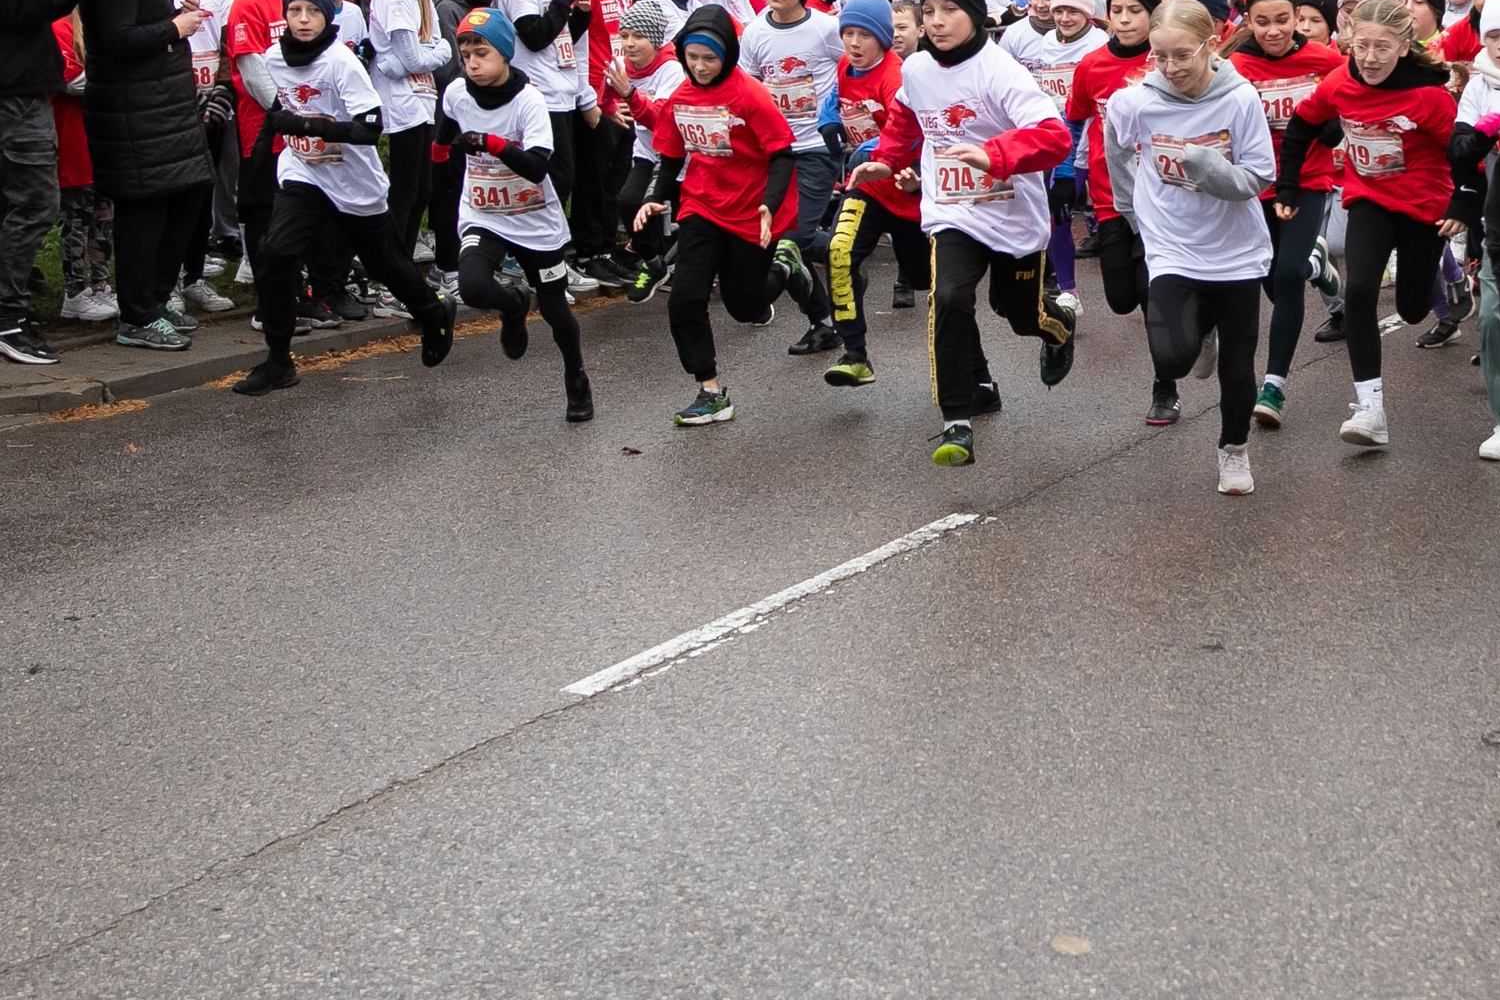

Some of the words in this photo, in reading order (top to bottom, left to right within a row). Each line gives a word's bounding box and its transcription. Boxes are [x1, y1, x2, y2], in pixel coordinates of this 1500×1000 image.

[270, 25, 287, 38] BIE
[1262, 96, 1294, 120] 218
[678, 122, 708, 146] 263
[1346, 140, 1370, 166] 19
[938, 166, 976, 192] 274
[472, 185, 511, 207] 341
[829, 197, 867, 322] LONSDALE
[1015, 269, 1035, 280] FBI
